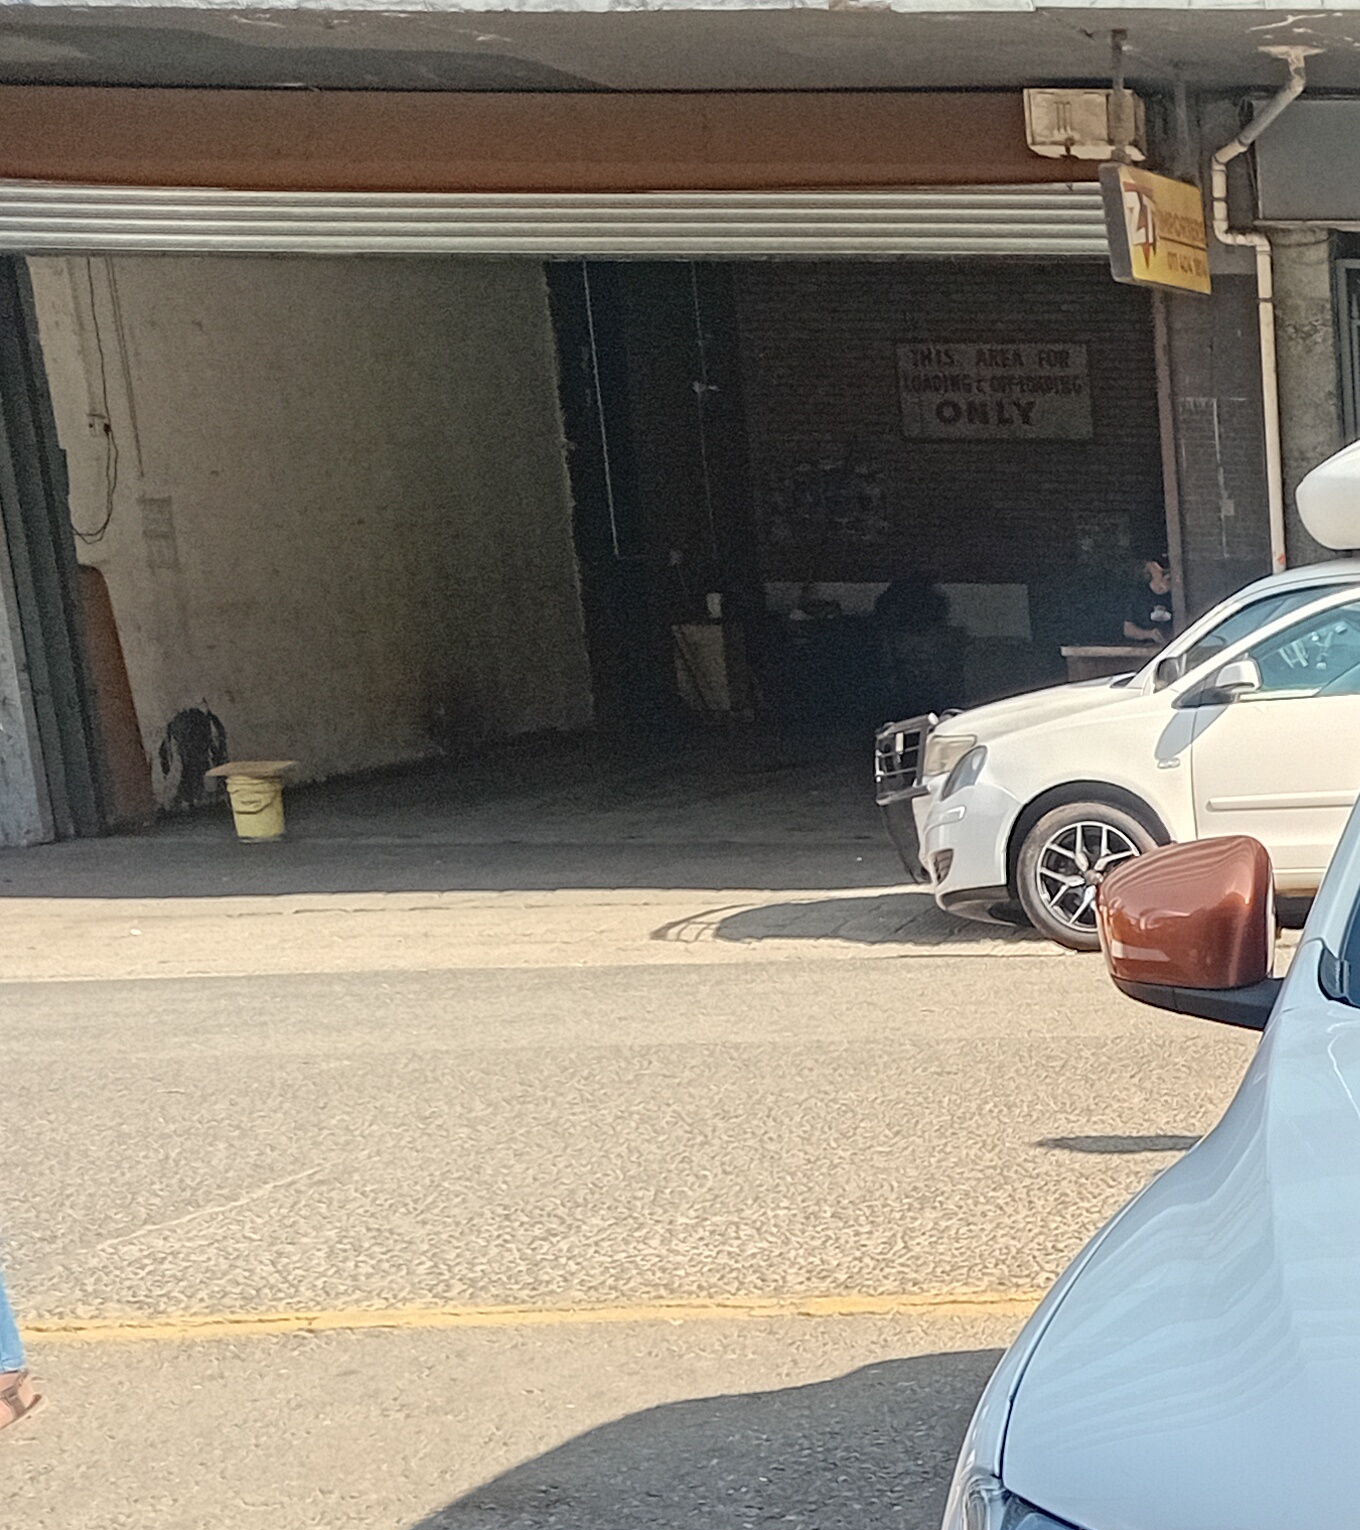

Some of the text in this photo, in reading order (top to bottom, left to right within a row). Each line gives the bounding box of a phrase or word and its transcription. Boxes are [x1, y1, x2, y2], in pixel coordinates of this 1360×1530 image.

[908, 347, 1071, 369] THIS AREA FOR
[903, 373, 973, 394] LOADING
[935, 399, 1037, 426] ONLY
